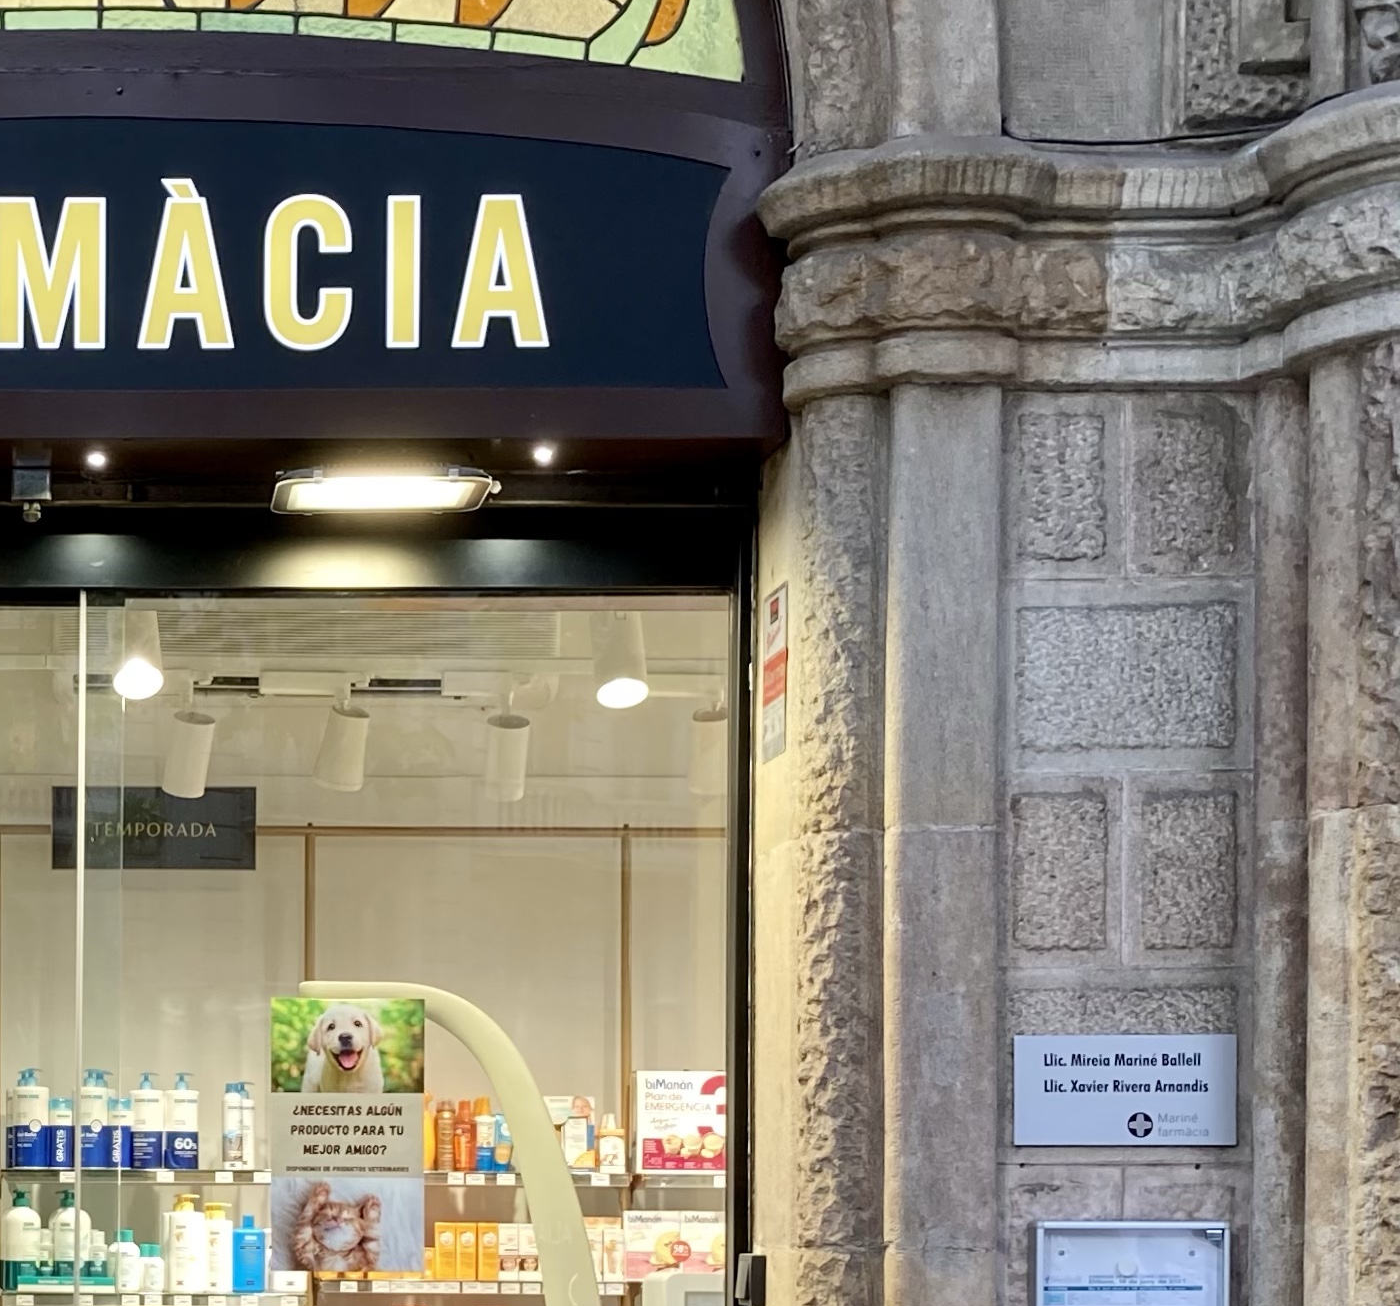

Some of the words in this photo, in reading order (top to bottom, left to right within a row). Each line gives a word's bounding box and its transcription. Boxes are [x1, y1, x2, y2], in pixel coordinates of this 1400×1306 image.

[93, 821, 218, 838] TEMPORADA
[1043, 1053, 1068, 1067] Llic.
[1070, 1053, 1111, 1067] Mireia
[1114, 1052, 1158, 1067] Mariné
[1161, 1052, 1202, 1067] Ballell
[1043, 1079, 1068, 1093] Llic.
[1070, 1080, 1109, 1093] Xavier
[1112, 1079, 1151, 1093] Rivera
[1154, 1078, 1209, 1093] Arnandis
[292, 1105, 362, 1117] ¿NECESITAS
[366, 1102, 403, 1117] ALGÚN
[290, 1124, 350, 1136] PRODUCTO
[353, 1125, 385, 1136] PARA
[389, 1125, 404, 1136] TU
[55, 1129, 66, 1163] GRATIS
[303, 1144, 341, 1155] MEJOR
[345, 1144, 388, 1156] AMIGO?
